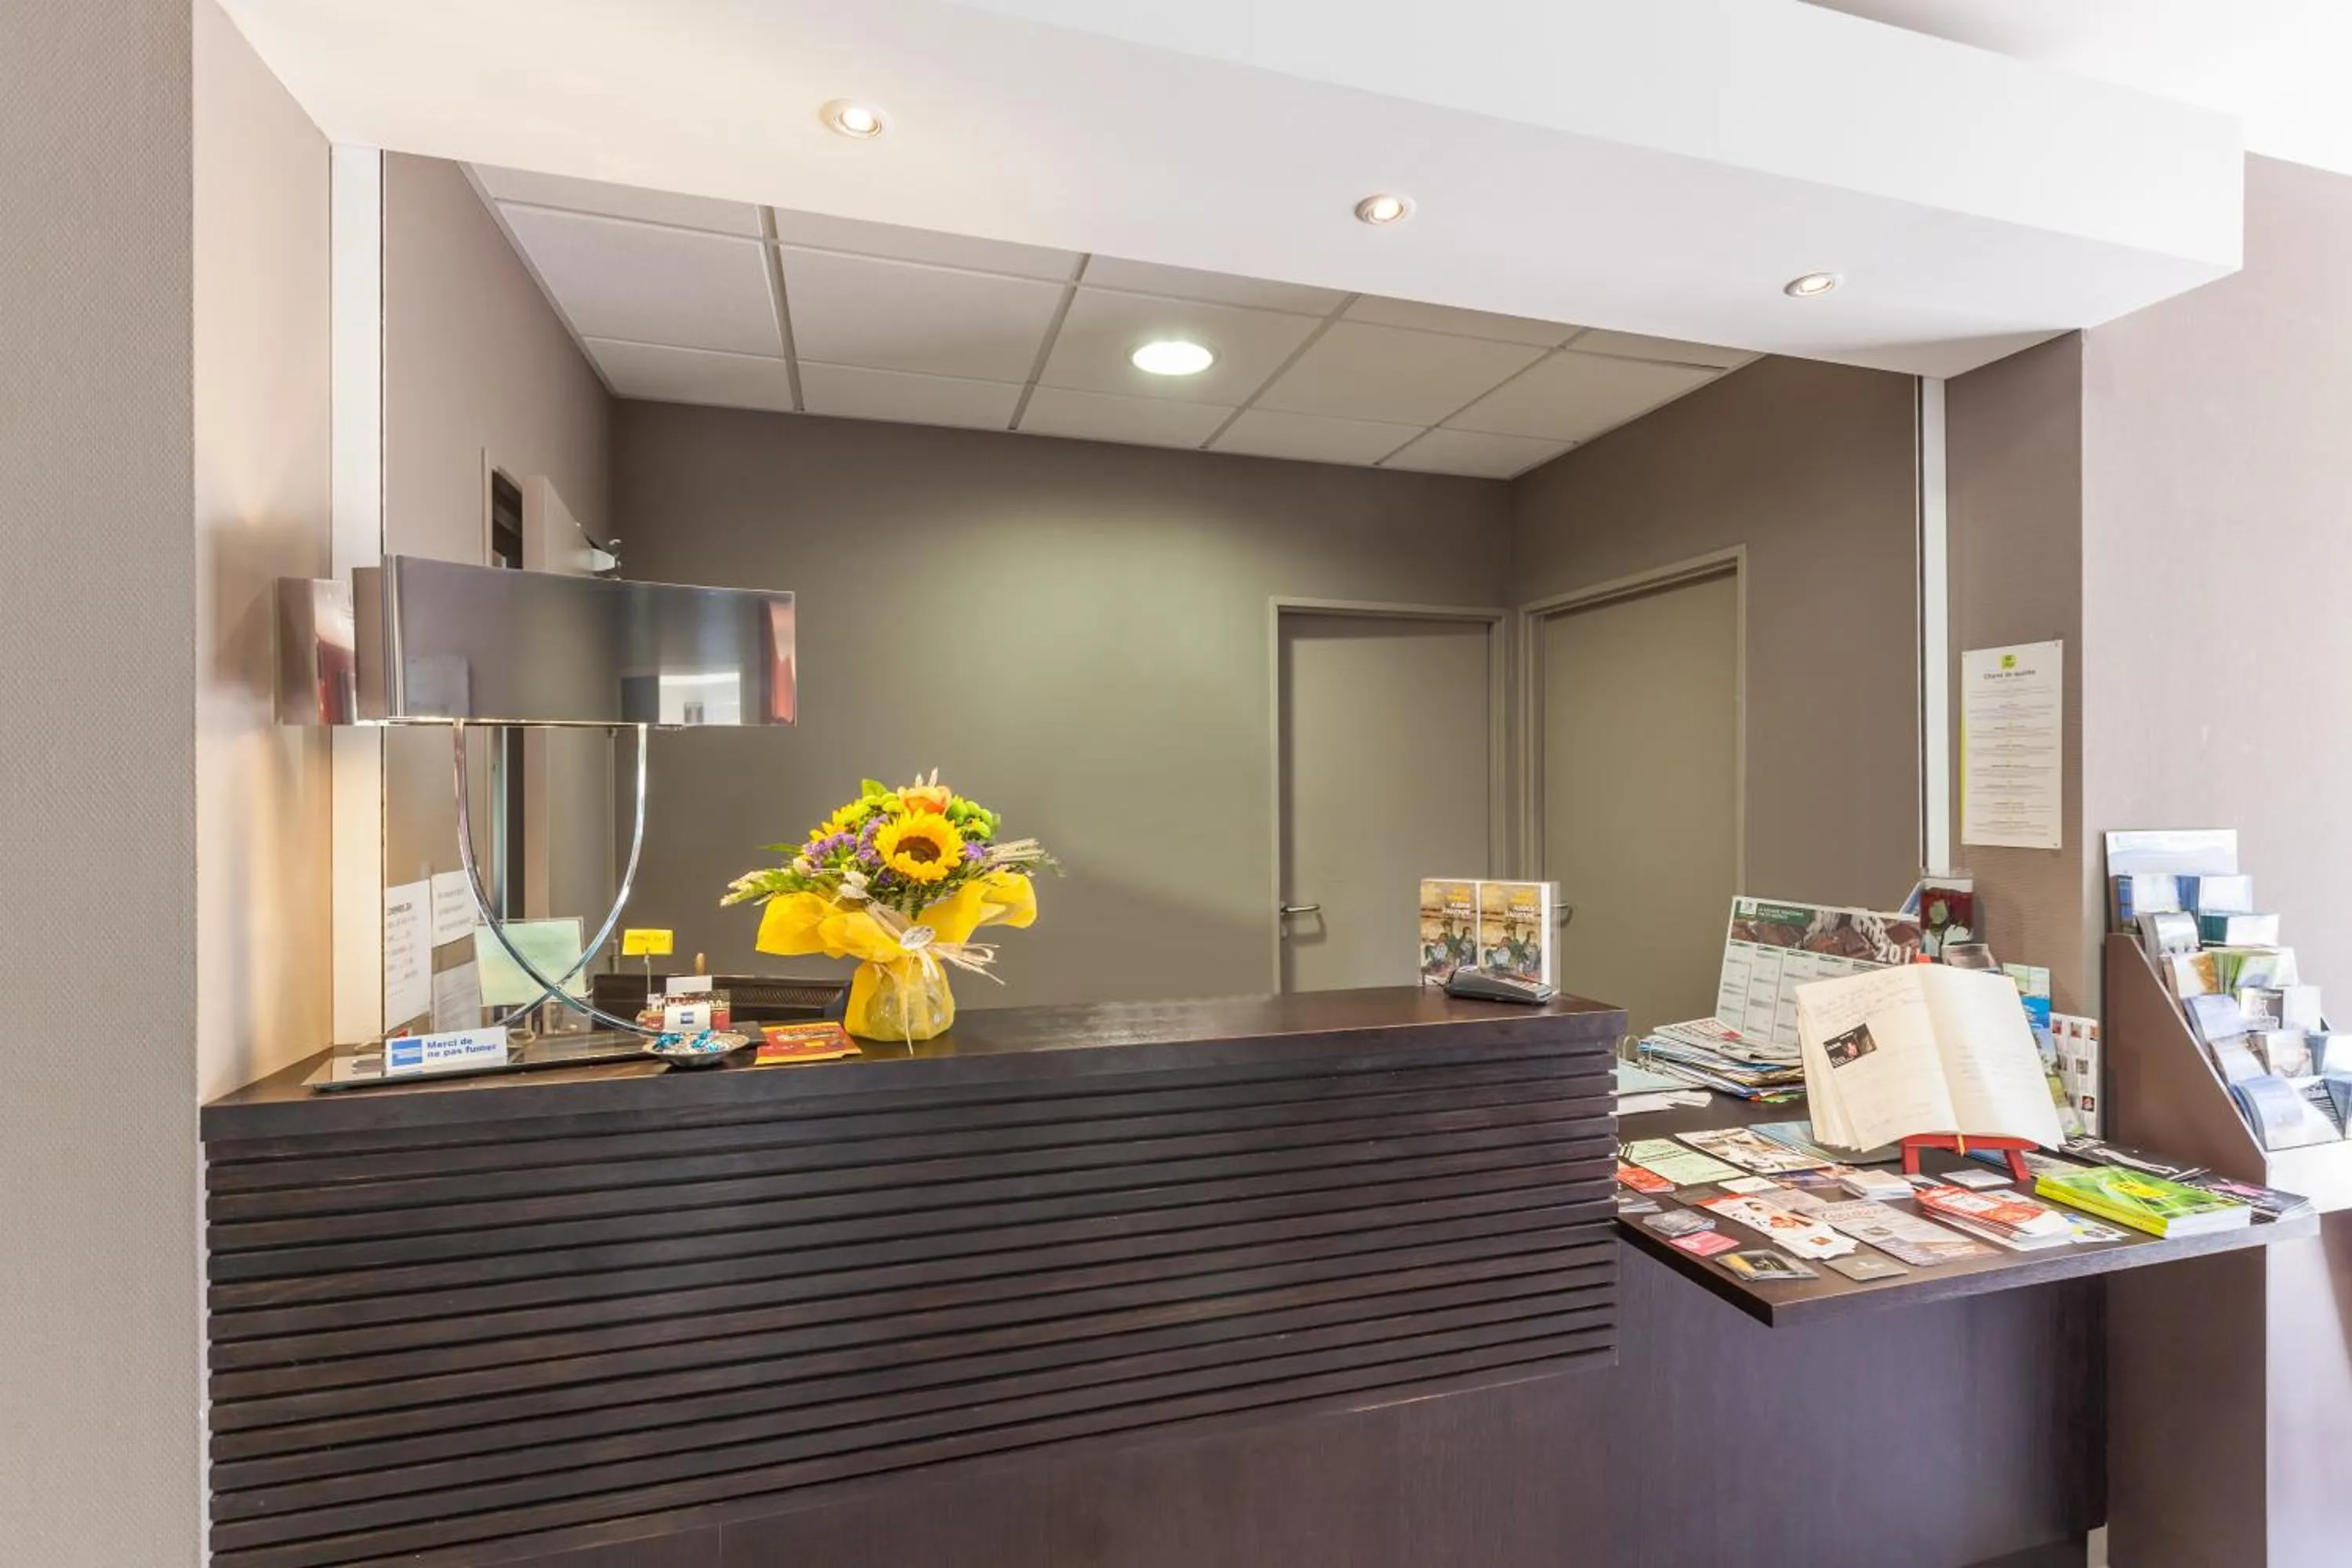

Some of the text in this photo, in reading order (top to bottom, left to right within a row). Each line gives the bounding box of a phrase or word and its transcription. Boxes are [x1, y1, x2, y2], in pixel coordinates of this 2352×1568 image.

[426, 1037, 473, 1049] Merci de
[444, 1048, 462, 1058] pas
[466, 1044, 496, 1053] fumer
